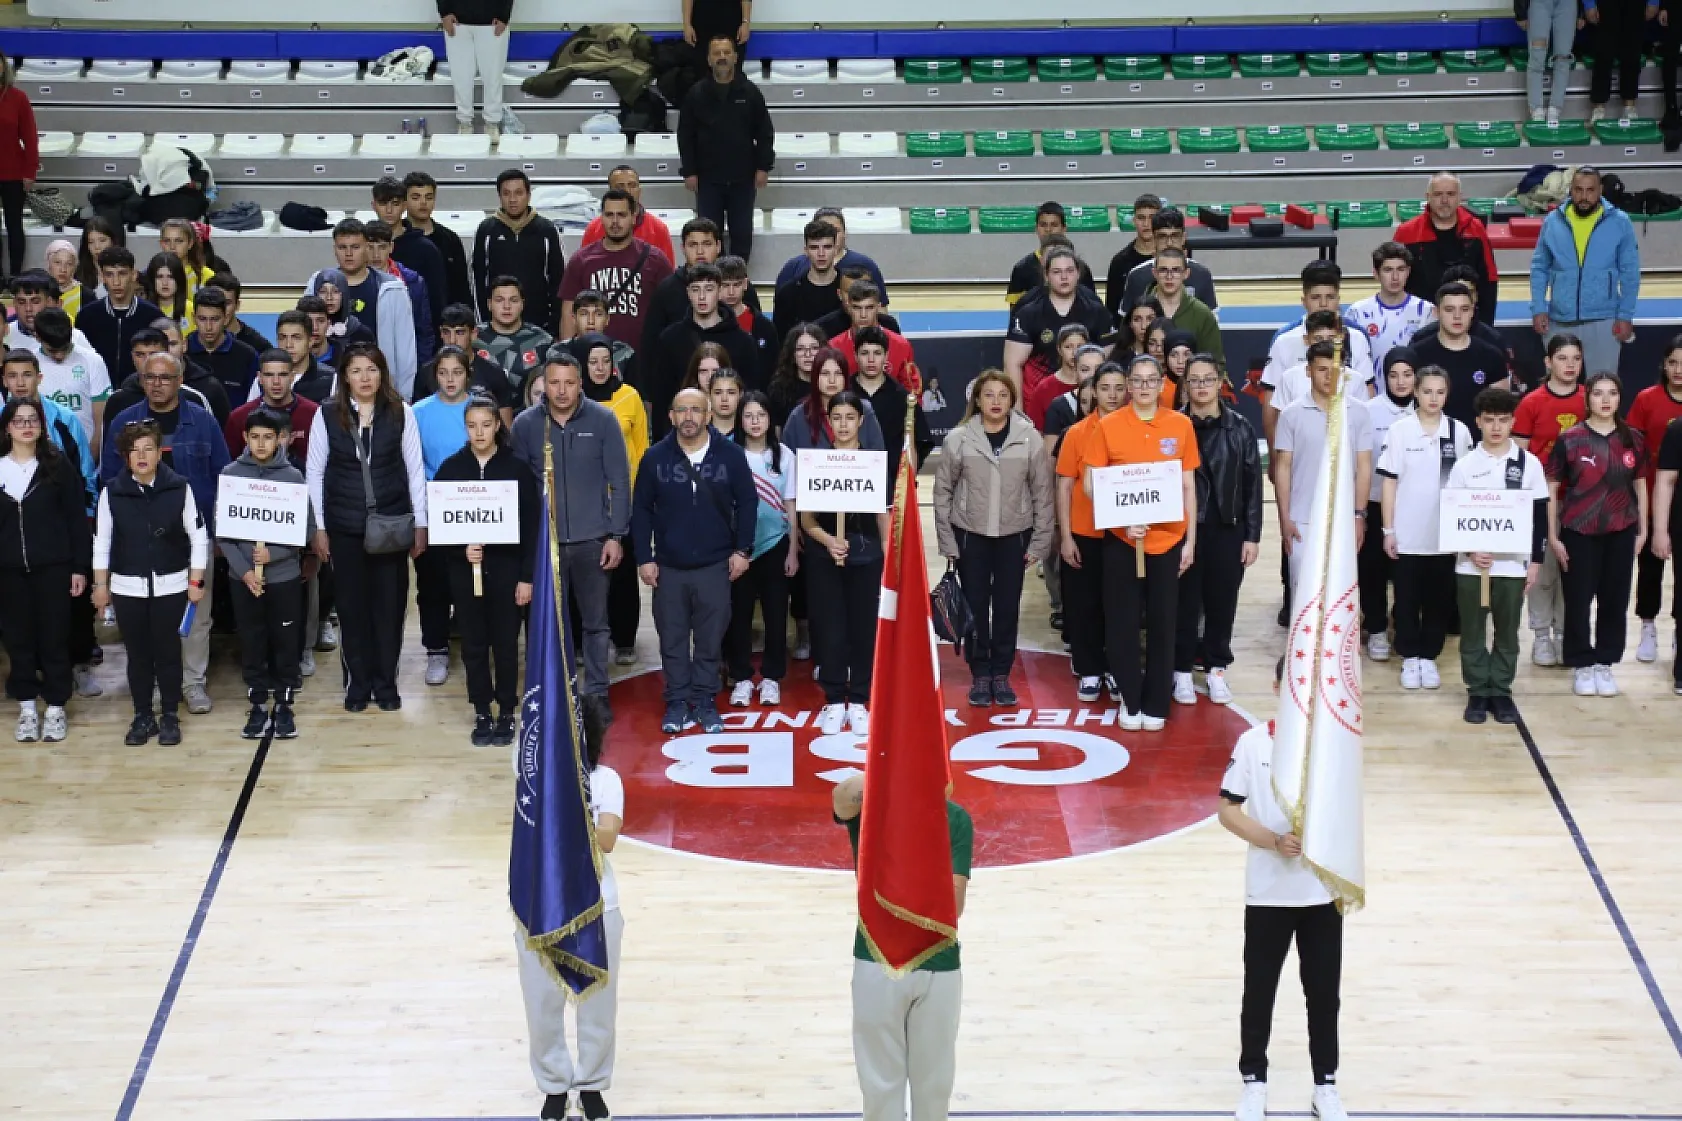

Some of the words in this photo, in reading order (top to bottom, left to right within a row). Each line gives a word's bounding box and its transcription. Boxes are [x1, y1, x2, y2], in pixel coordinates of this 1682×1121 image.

[607, 291, 639, 317] ESS
[808, 478, 875, 492] ISPARTA
[1115, 488, 1161, 507] İZMİR
[228, 504, 295, 525] BURDUR
[443, 506, 503, 523] DENİZLİ
[1457, 518, 1514, 531] KONYA
[988, 709, 1118, 726] HEP
